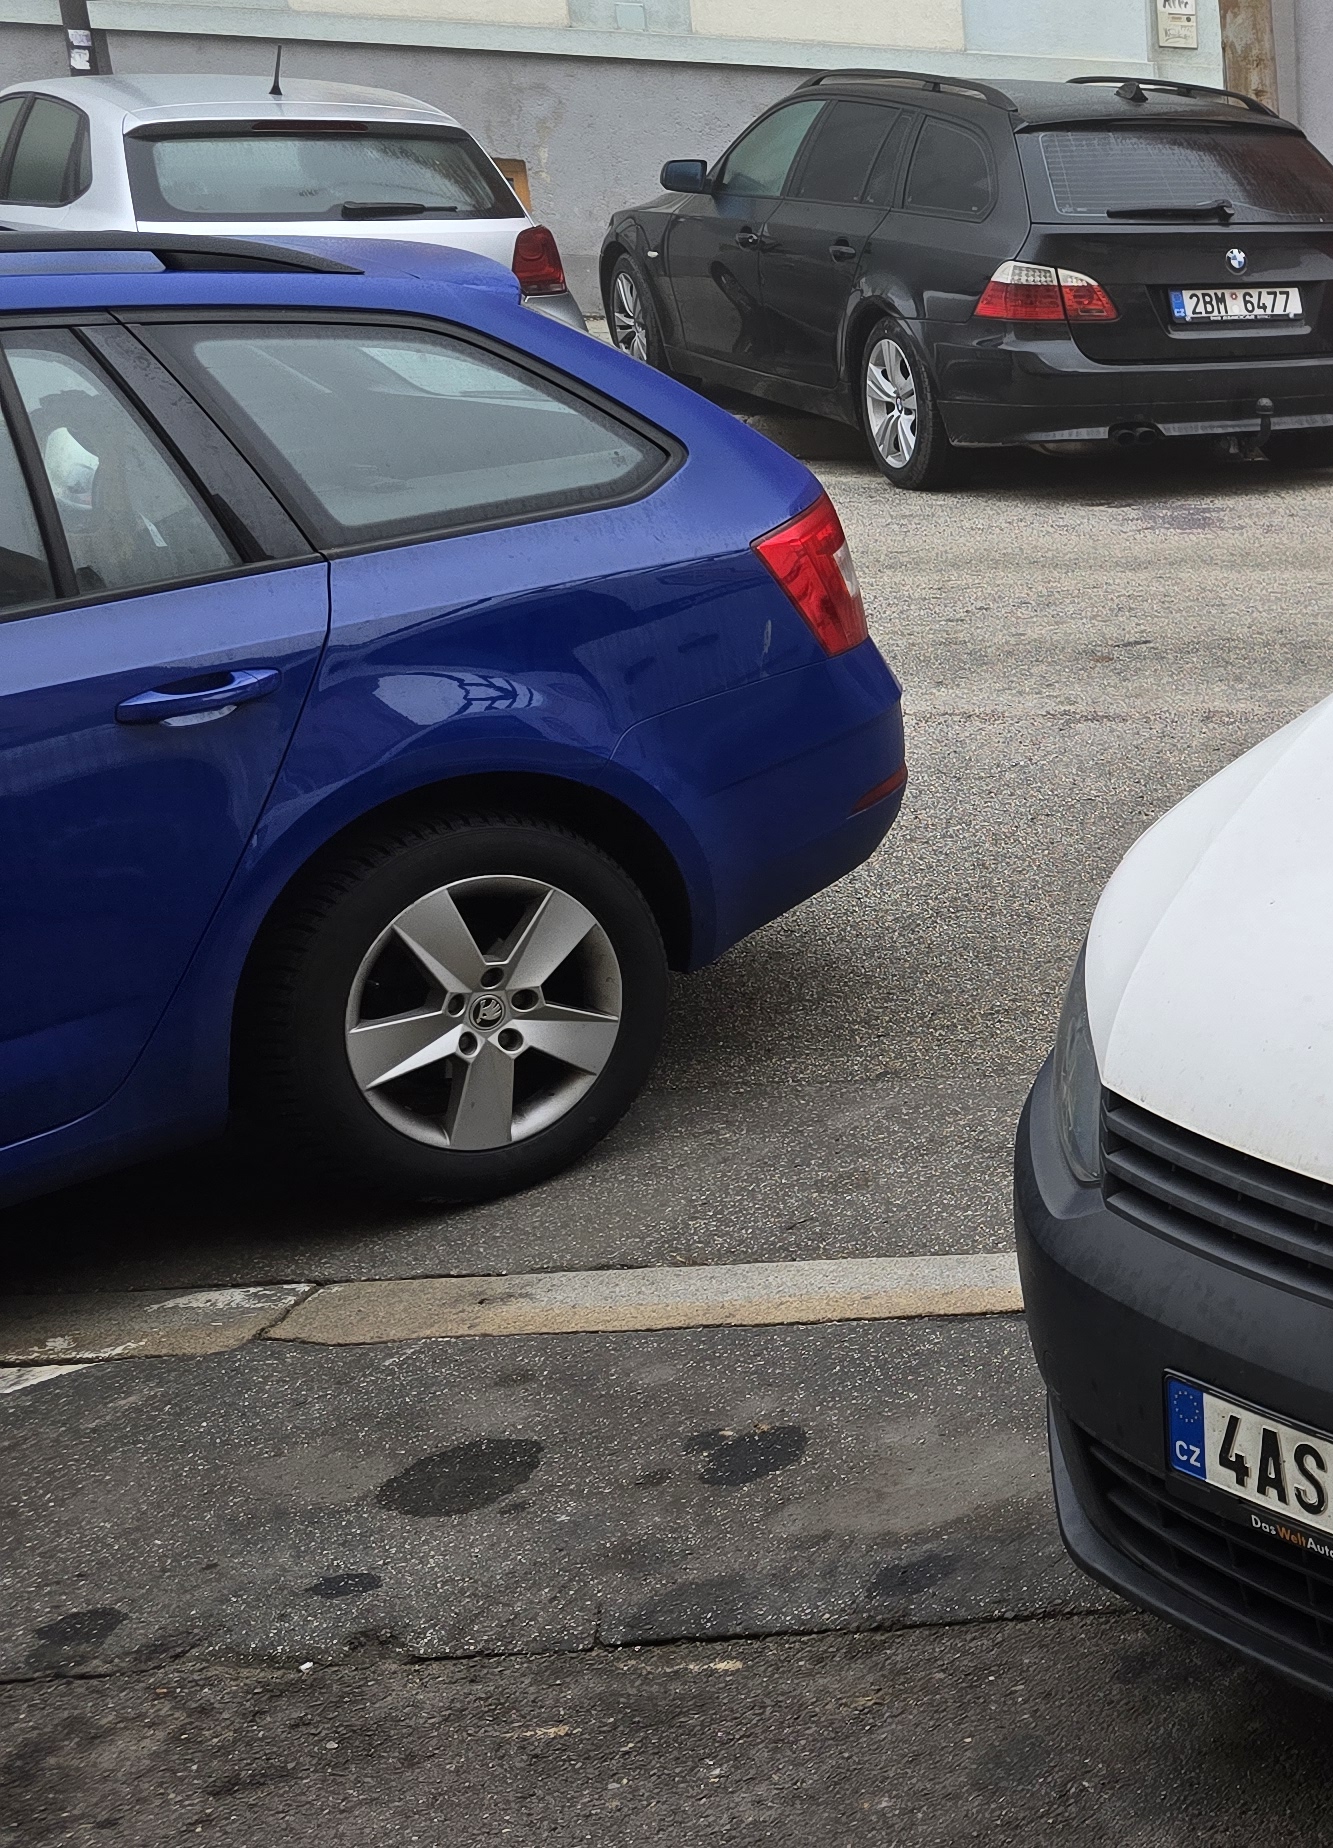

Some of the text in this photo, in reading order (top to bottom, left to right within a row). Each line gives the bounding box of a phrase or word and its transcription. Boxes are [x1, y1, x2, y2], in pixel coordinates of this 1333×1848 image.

[1189, 290, 1290, 315] 2BM 6477
[1175, 1440, 1201, 1468] CZ
[1217, 1415, 1328, 1515] 4AS
